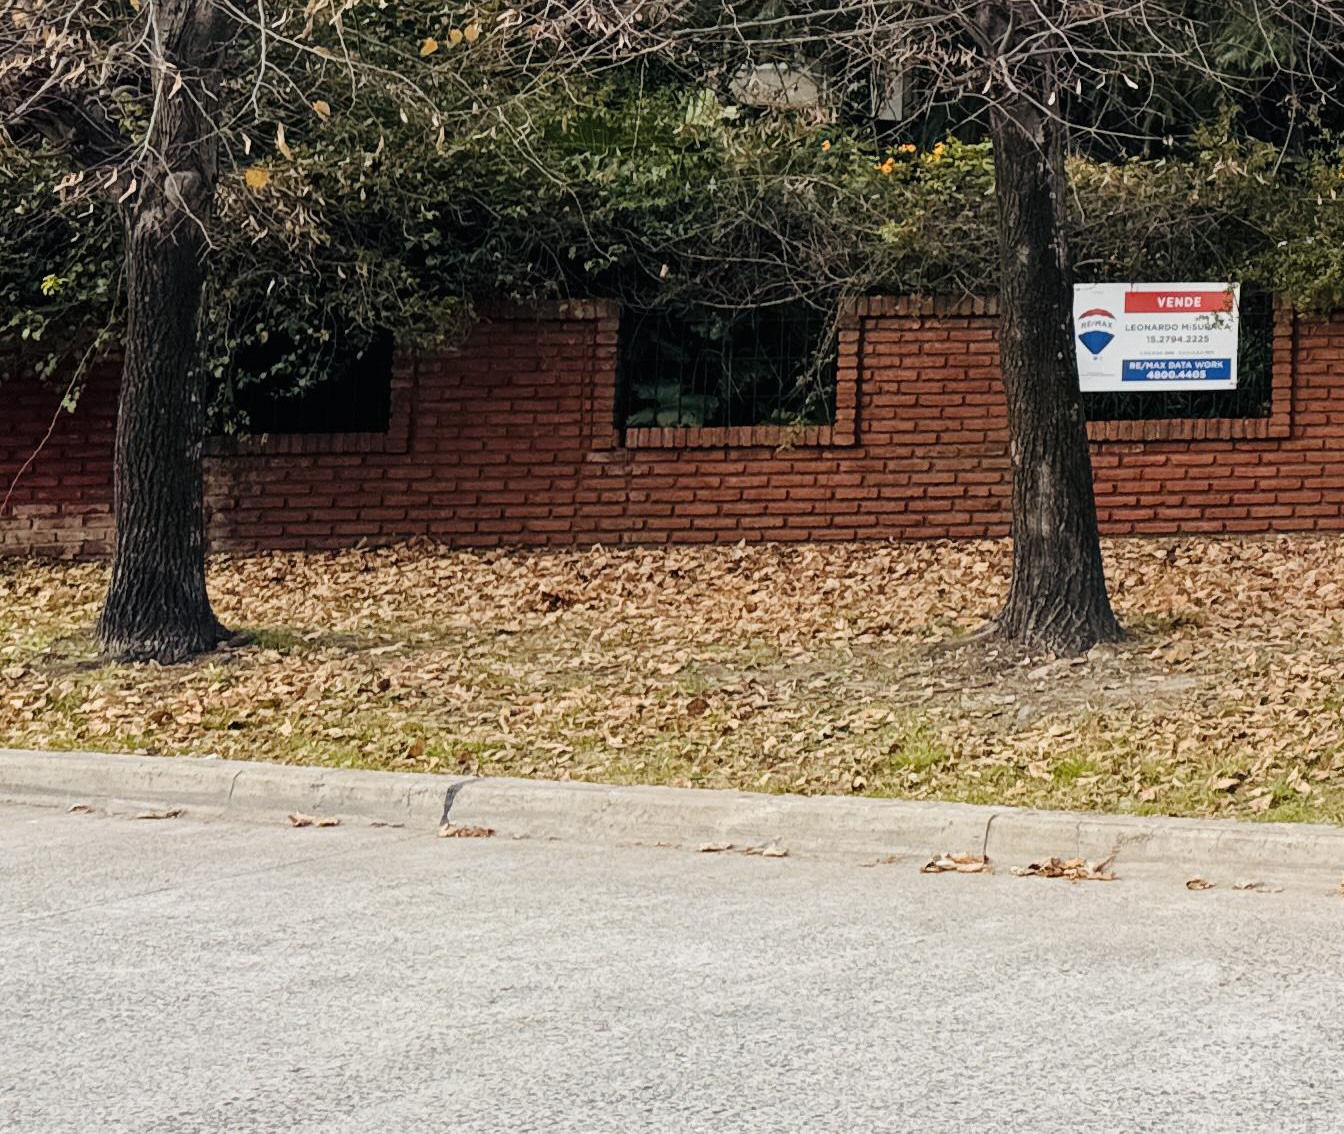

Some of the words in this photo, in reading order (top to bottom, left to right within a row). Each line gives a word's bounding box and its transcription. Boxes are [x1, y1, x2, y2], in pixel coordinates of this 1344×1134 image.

[1157, 296, 1202, 308] VENDE
[1081, 320, 1112, 329] RE/MAX
[1125, 323, 1178, 331] LEONARDO
[1129, 362, 1166, 370] RE/MAX
[1168, 361, 1192, 369] DATA
[1195, 360, 1223, 369] WORK
